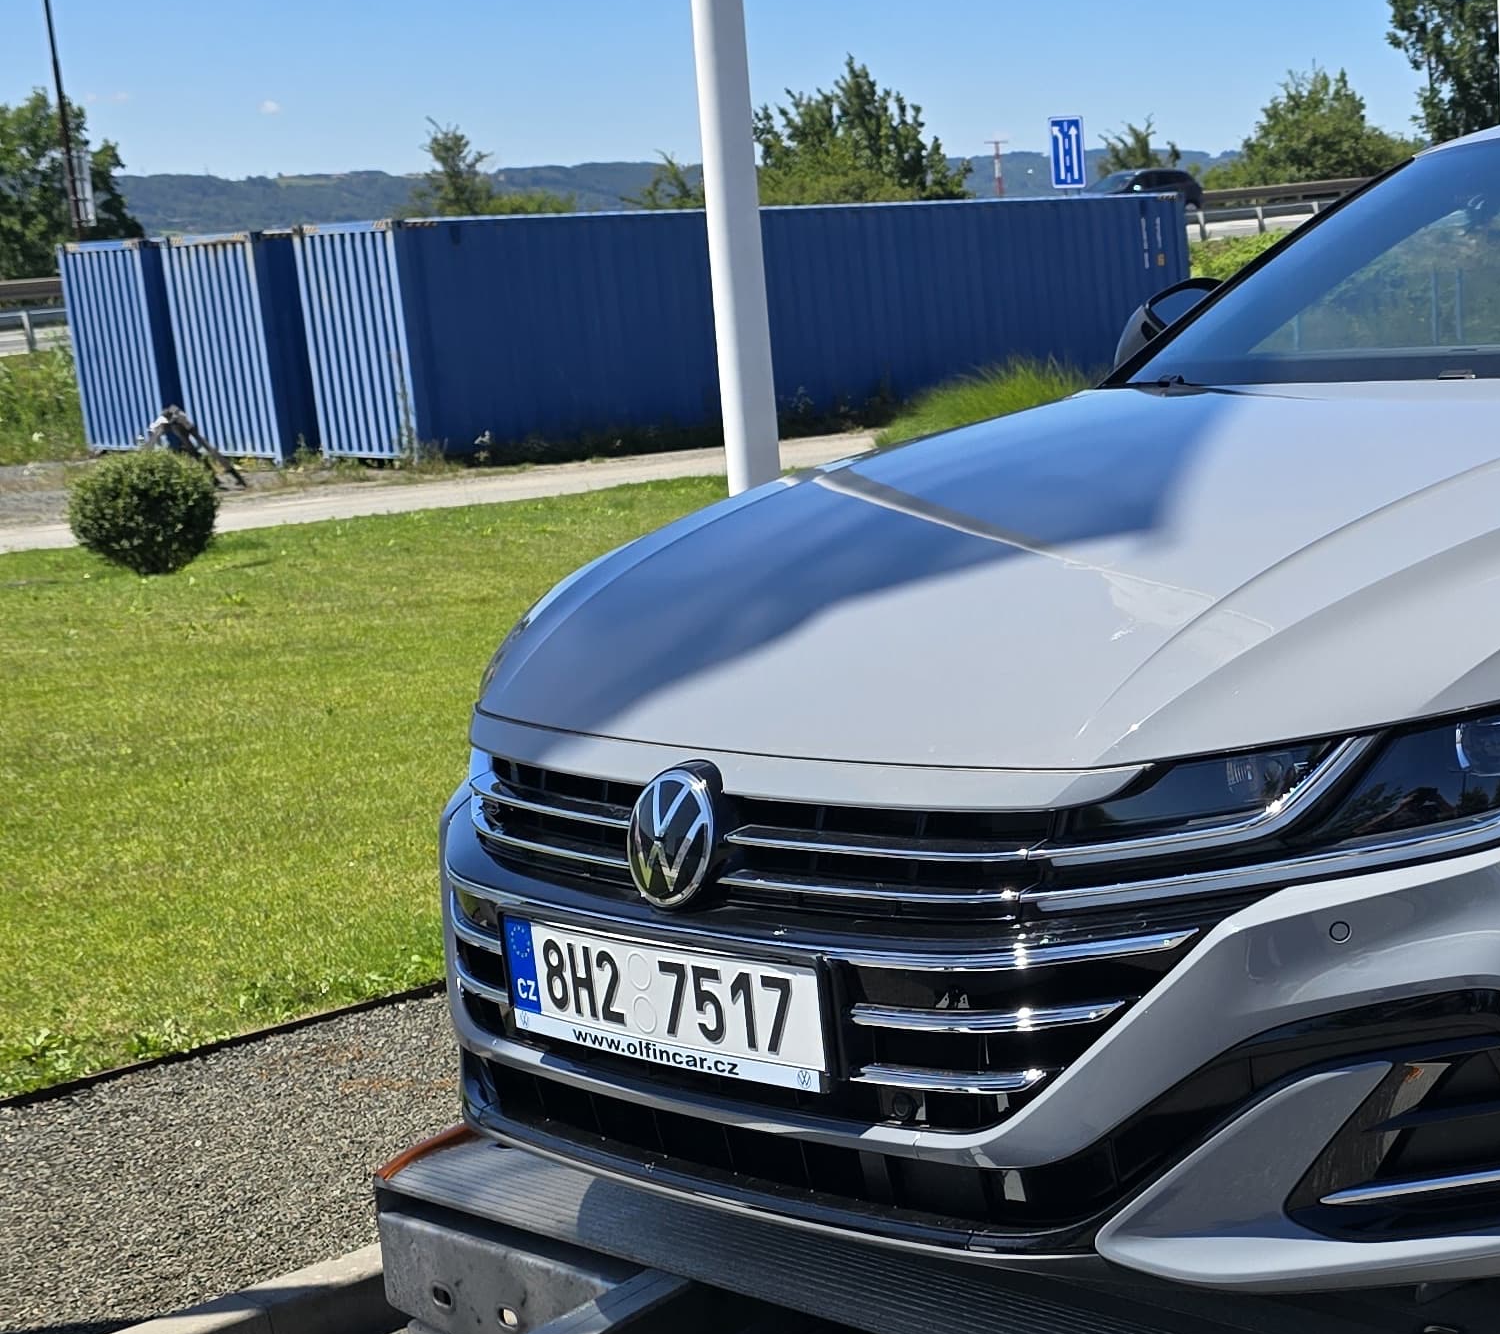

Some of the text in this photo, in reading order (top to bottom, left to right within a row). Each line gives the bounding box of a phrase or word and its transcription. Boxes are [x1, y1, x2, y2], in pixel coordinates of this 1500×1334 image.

[517, 977, 538, 1001] CZ
[542, 938, 792, 1055] 8H2 7517
[572, 1028, 740, 1076] www.olfincar.cz
